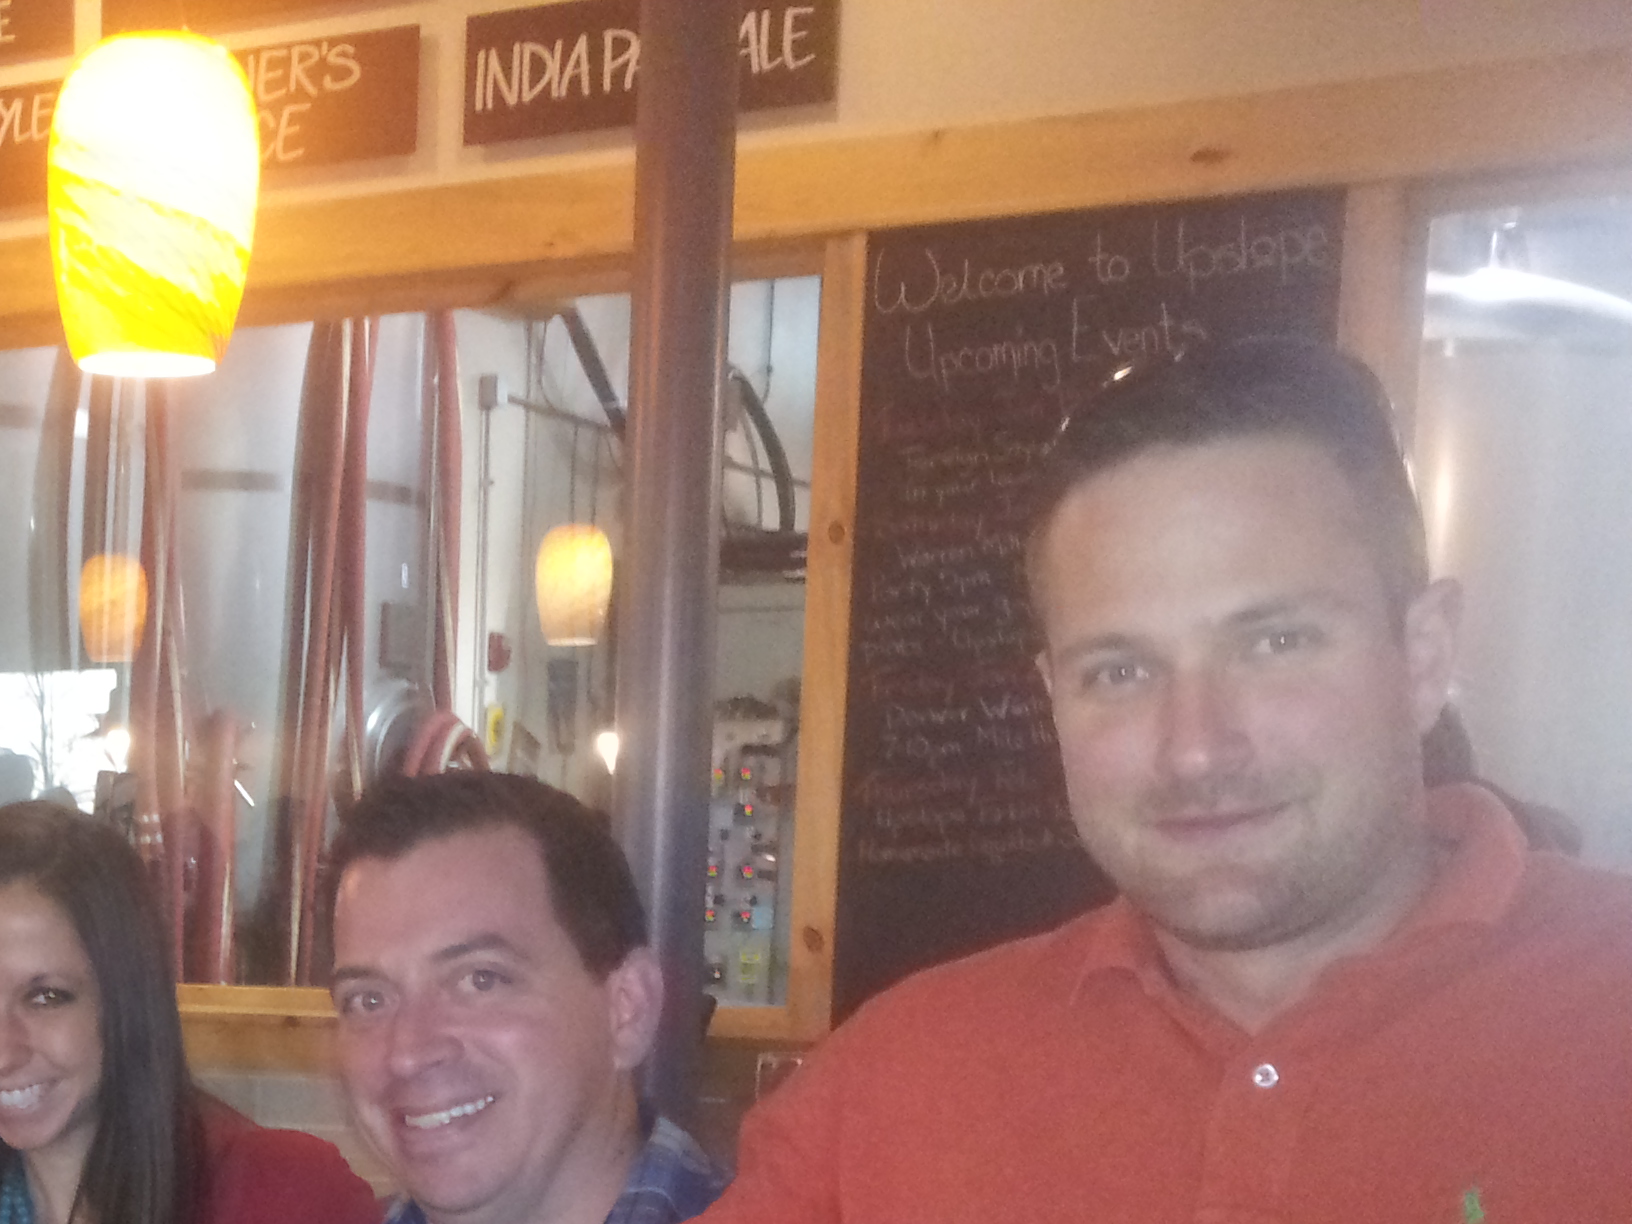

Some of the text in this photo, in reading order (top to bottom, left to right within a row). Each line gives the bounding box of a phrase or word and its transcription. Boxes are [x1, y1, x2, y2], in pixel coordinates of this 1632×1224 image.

[247, 41, 362, 102] ER'S
[474, 34, 591, 113] INDIA
[738, 7, 816, 75] ALE
[874, 215, 1328, 314] Welcome to Upslope
[904, 318, 1062, 392] Upcoming
